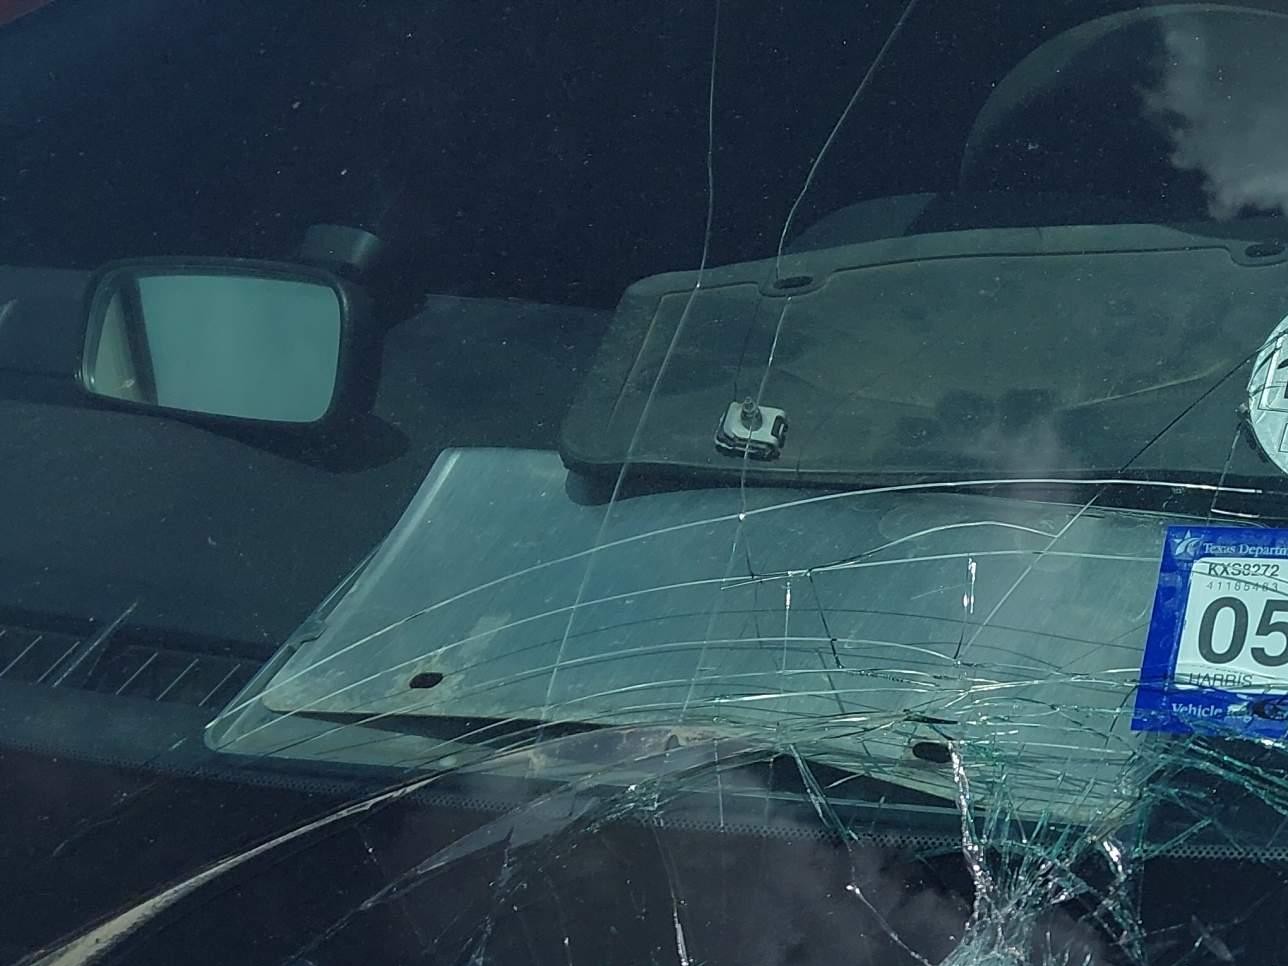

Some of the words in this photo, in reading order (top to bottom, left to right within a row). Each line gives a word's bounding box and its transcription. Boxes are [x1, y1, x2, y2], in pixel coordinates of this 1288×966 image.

[1202, 542, 1236, 554] Texas
[1208, 562, 1280, 577] KXS8272
[1189, 672, 1253, 688] HARRIS
[1171, 703, 1223, 718] Vehicle
